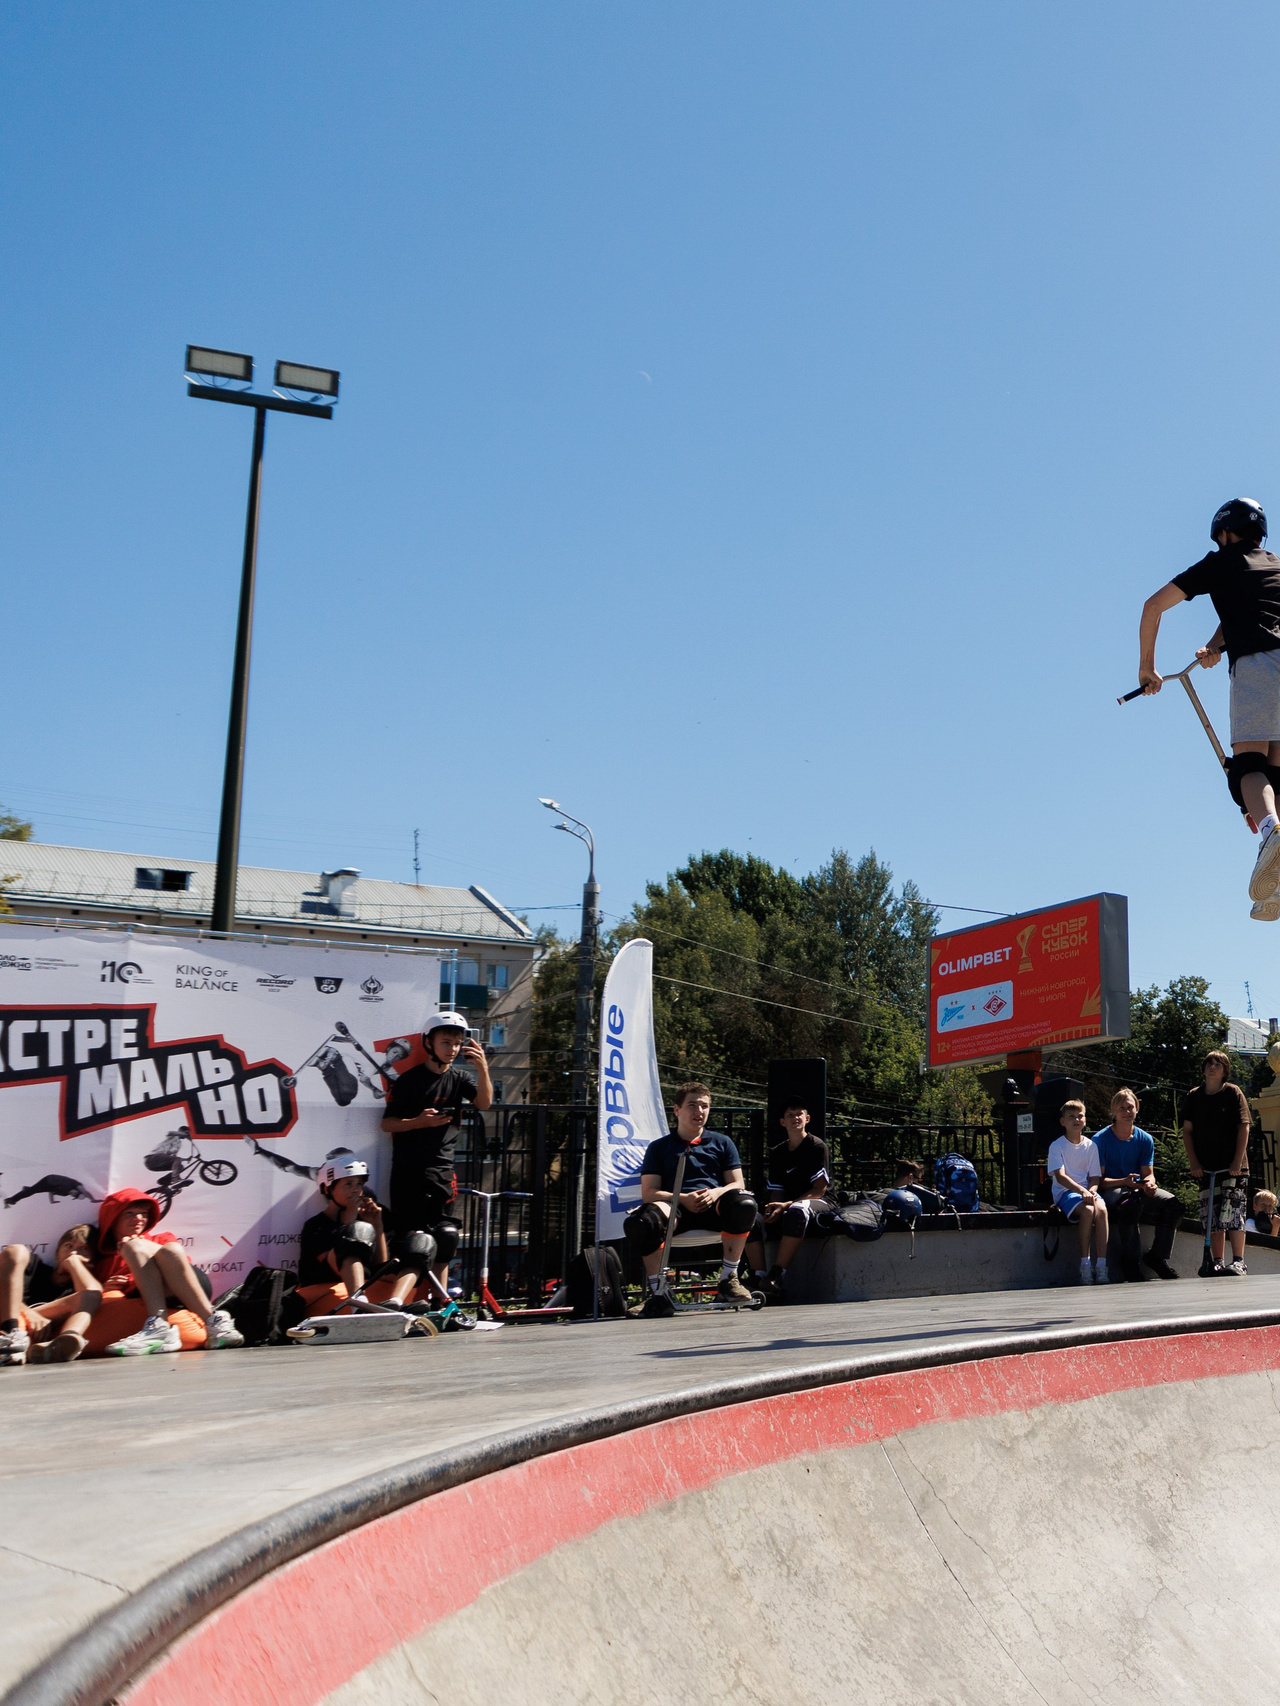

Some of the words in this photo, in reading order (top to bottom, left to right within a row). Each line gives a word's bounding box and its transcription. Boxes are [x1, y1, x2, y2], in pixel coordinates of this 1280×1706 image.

[1042, 916, 1088, 939] СУПЕР
[1042, 930, 1088, 954] КУБОК
[938, 946, 1012, 976] OLIMPBET
[1050, 949, 1080, 962] РОССИИ
[176, 964, 212, 977] KING
[215, 969, 229, 978] OF
[256, 977, 294, 985] RECORD
[320, 984, 336, 992] GO
[1020, 984, 1049, 998] НИЖНИЙ
[1049, 976, 1086, 992] НОВГОРОД
[1046, 991, 1067, 1003] ИЮЛЯ
[936, 1041, 951, 1054] 12+
[77, 1050, 236, 1120] МАЛЬ
[197, 1073, 284, 1125] НО
